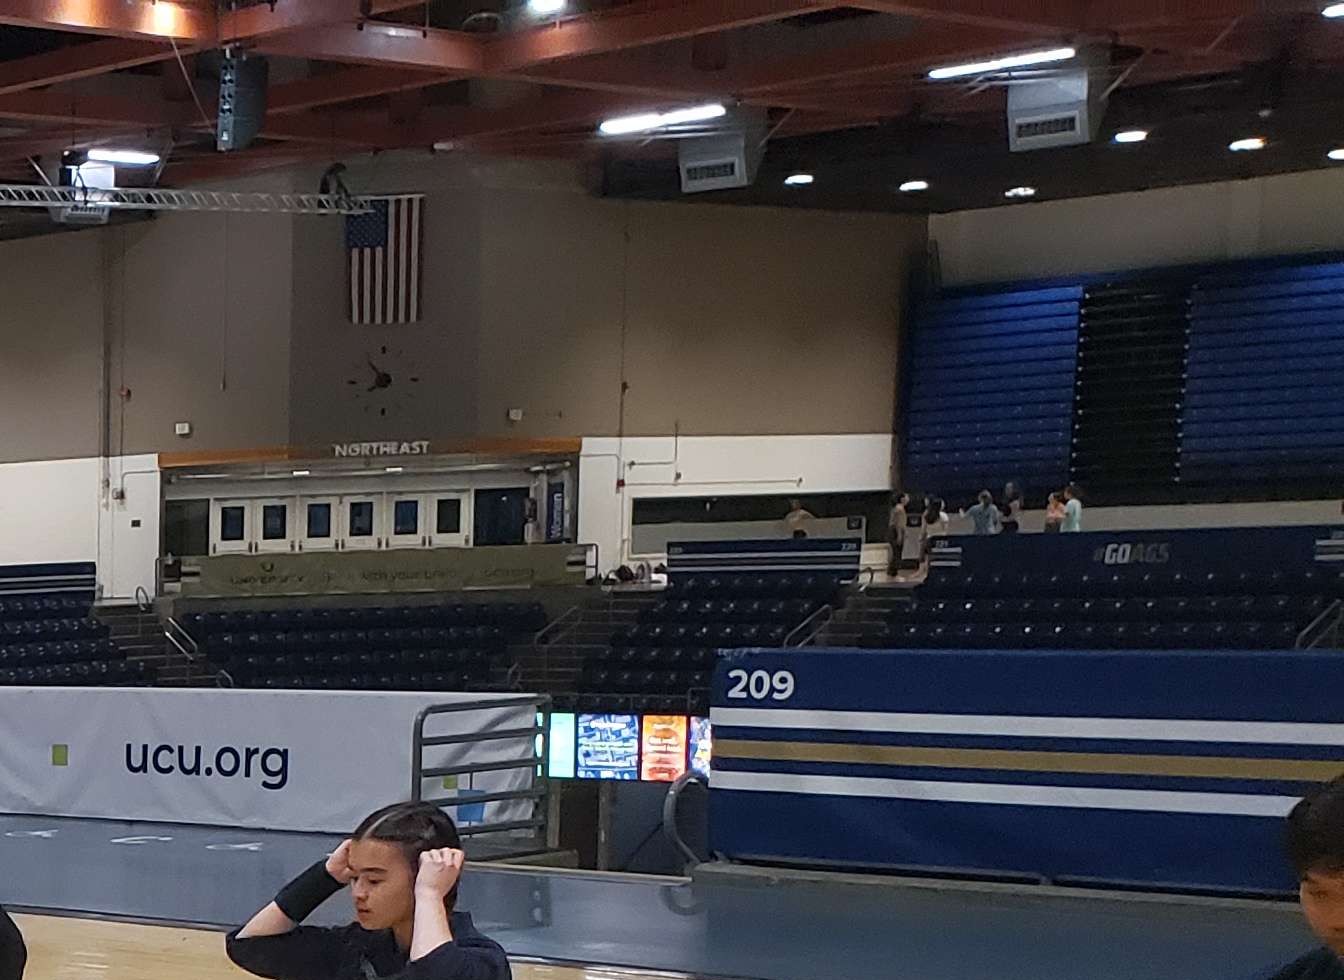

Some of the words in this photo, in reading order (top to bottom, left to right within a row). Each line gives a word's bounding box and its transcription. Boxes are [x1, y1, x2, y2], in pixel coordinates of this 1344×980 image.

[333, 440, 430, 457] NORTHEAST
[727, 669, 794, 700] 209
[125, 743, 289, 790] ucu.org
